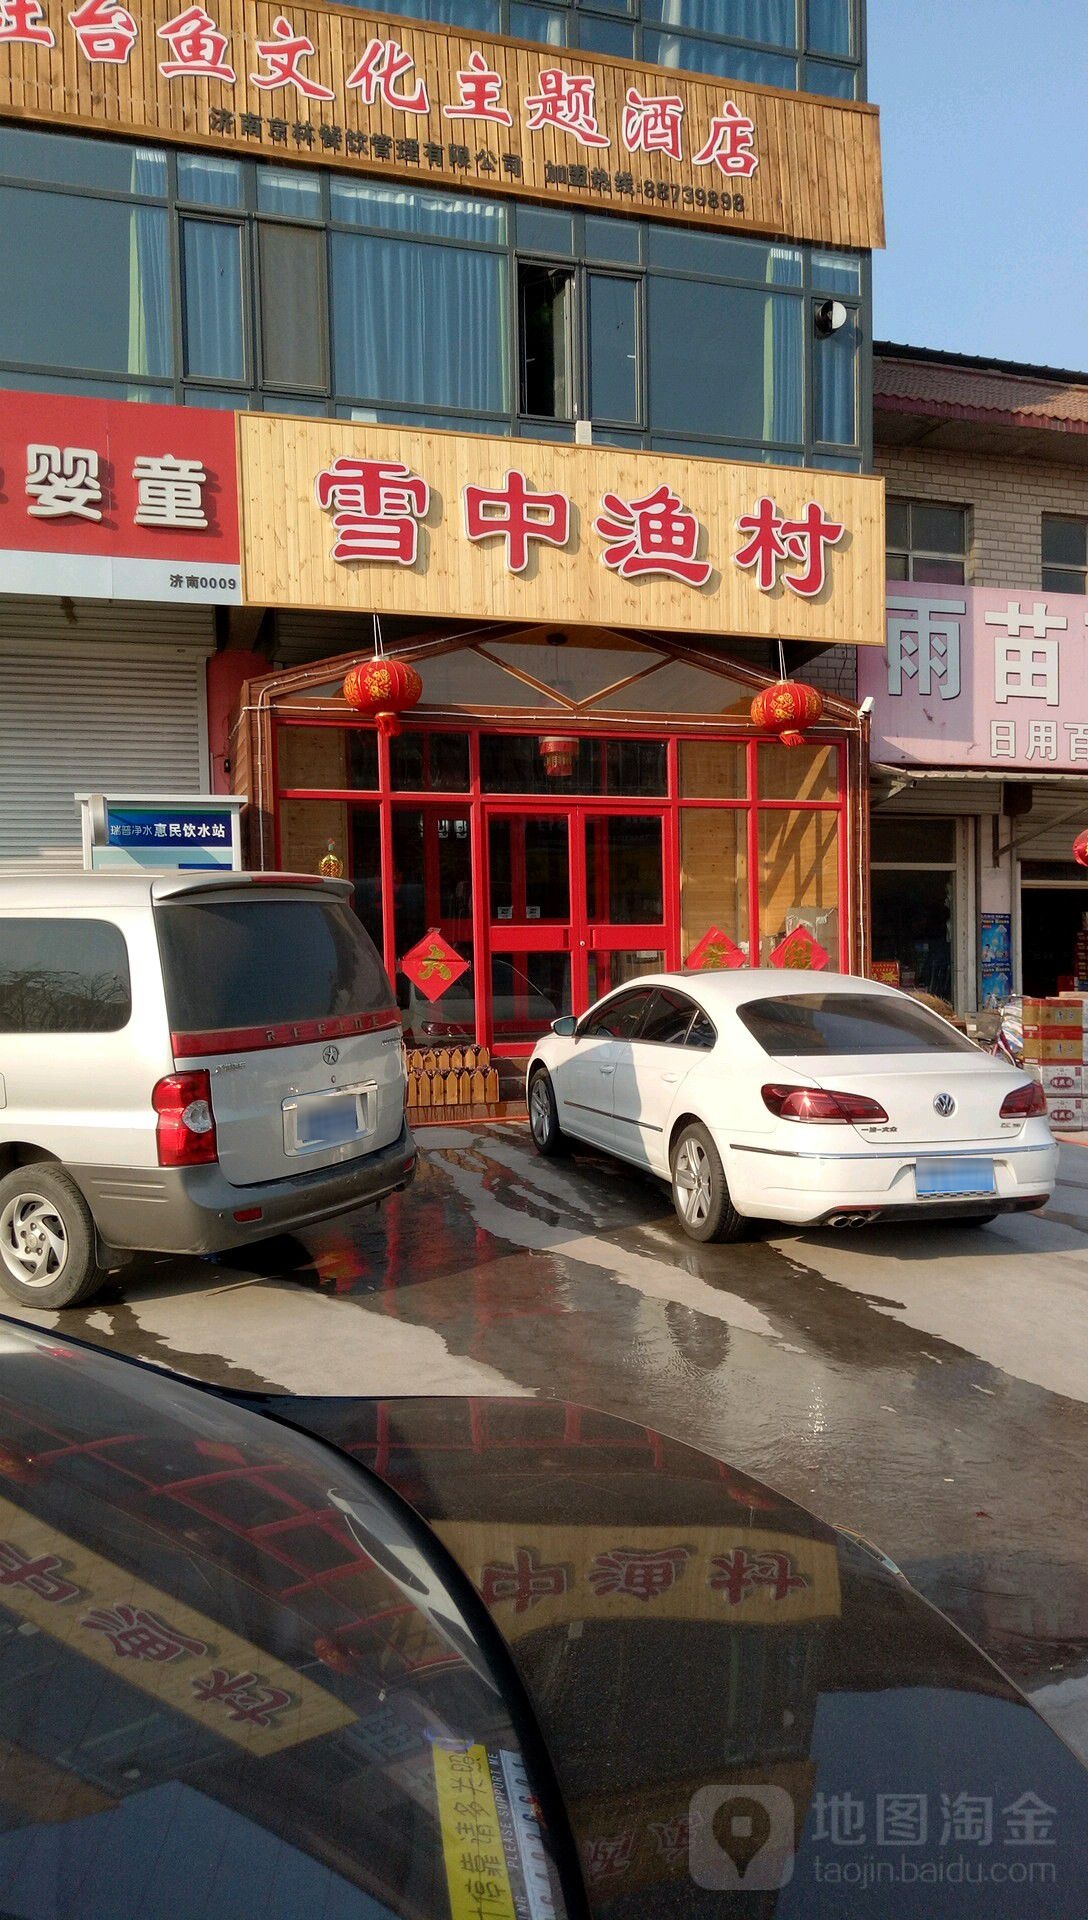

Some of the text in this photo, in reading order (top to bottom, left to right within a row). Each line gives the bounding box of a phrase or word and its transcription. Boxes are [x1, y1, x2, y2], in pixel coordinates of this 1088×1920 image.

[209, 107, 522, 178] 济南京林餐饮管理有限公司
[25, 443, 209, 530] 婴童
[315, 456, 845, 598] 雪中渔村
[169, 573, 237, 591] 济南0009
[886, 596, 1088, 706] 雨苗
[154, 823, 226, 838] 惠民饮水站
